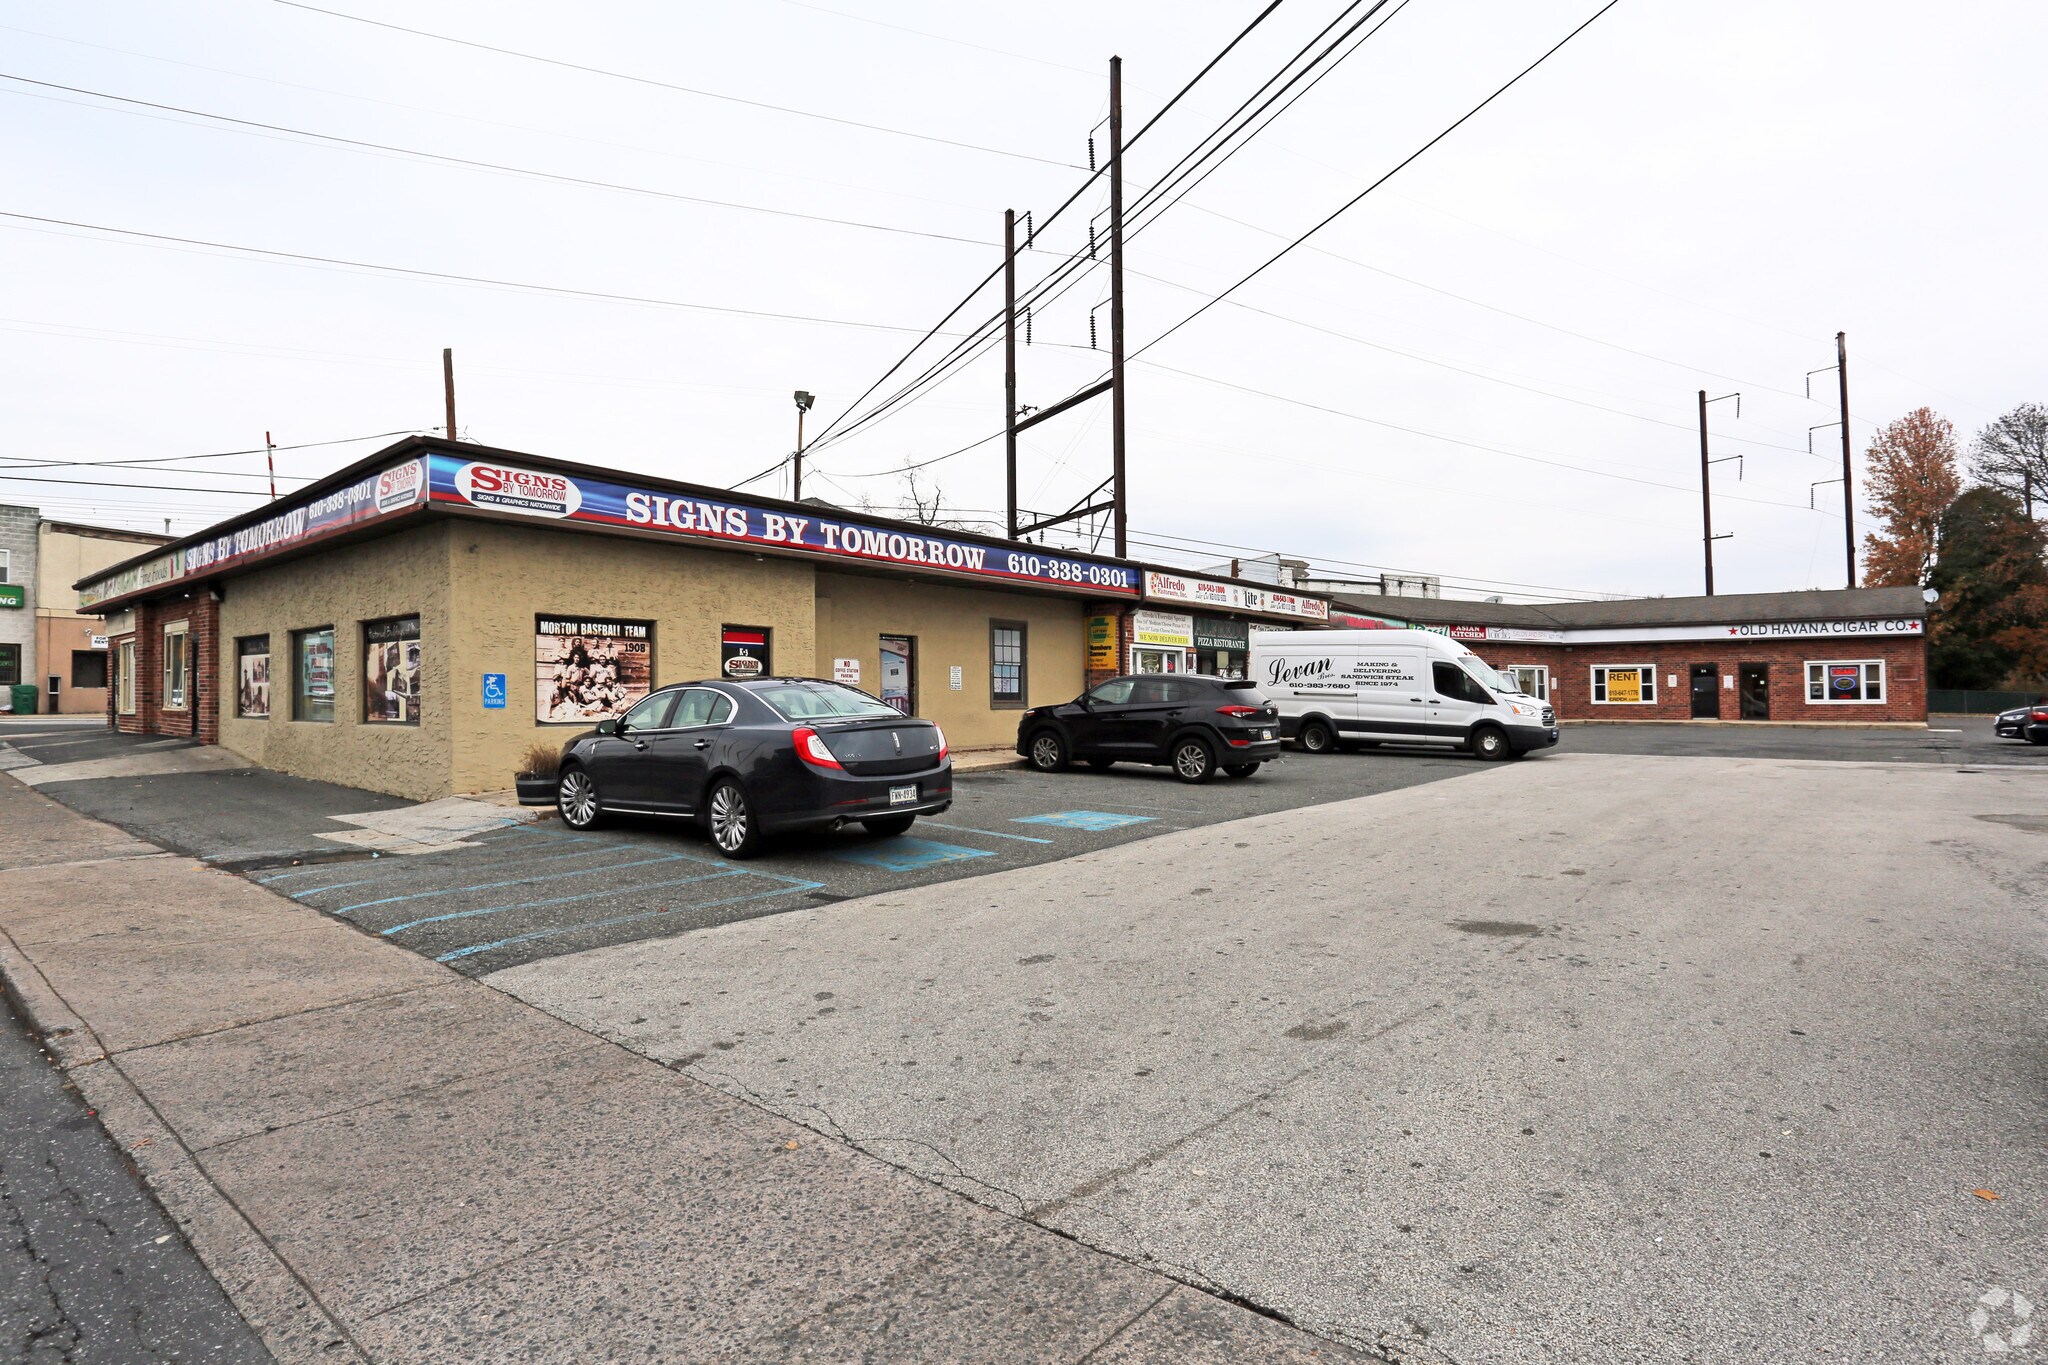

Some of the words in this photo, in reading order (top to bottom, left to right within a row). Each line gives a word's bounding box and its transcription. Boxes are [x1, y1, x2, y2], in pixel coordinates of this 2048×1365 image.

[380, 462, 417, 496] SIGNS
[471, 466, 566, 491] SIGNS
[309, 480, 371, 519] 610-338-0301
[503, 482, 514, 494] BY
[518, 485, 566, 501] TOMORROW
[477, 494, 494, 502] SIGNS
[502, 497, 528, 507] GRAPHICS
[530, 502, 561, 511] NATIONWIDE
[186, 542, 215, 570] SIGNS
[218, 535, 232, 561] BY
[234, 507, 306, 555] TOMORROW
[626, 492, 748, 537] SIGNS
[763, 512, 808, 544] BY
[820, 523, 986, 571] TOMORROW
[151, 561, 168, 582] Foods
[1008, 554, 1128, 588] 610-338-0301
[1158, 576, 1185, 591] Alfredo
[1243, 590, 1257, 608] Lite
[1301, 599, 1320, 611] Alfredo
[540, 621, 578, 634] MORTON
[581, 623, 620, 636] BASEBALL
[624, 626, 646, 638] TEAM
[1740, 625, 1767, 636] OLD
[1772, 622, 1828, 635] HAVANA
[1833, 620, 1878, 633] CIGAR
[1885, 619, 1908, 631] CO.
[624, 643, 645, 652] 1908
[1197, 637, 1213, 647] PIZZA
[1214, 638, 1245, 649] RISTORANTE
[1267, 657, 1336, 687] Levan
[1609, 673, 1638, 681] RENT
